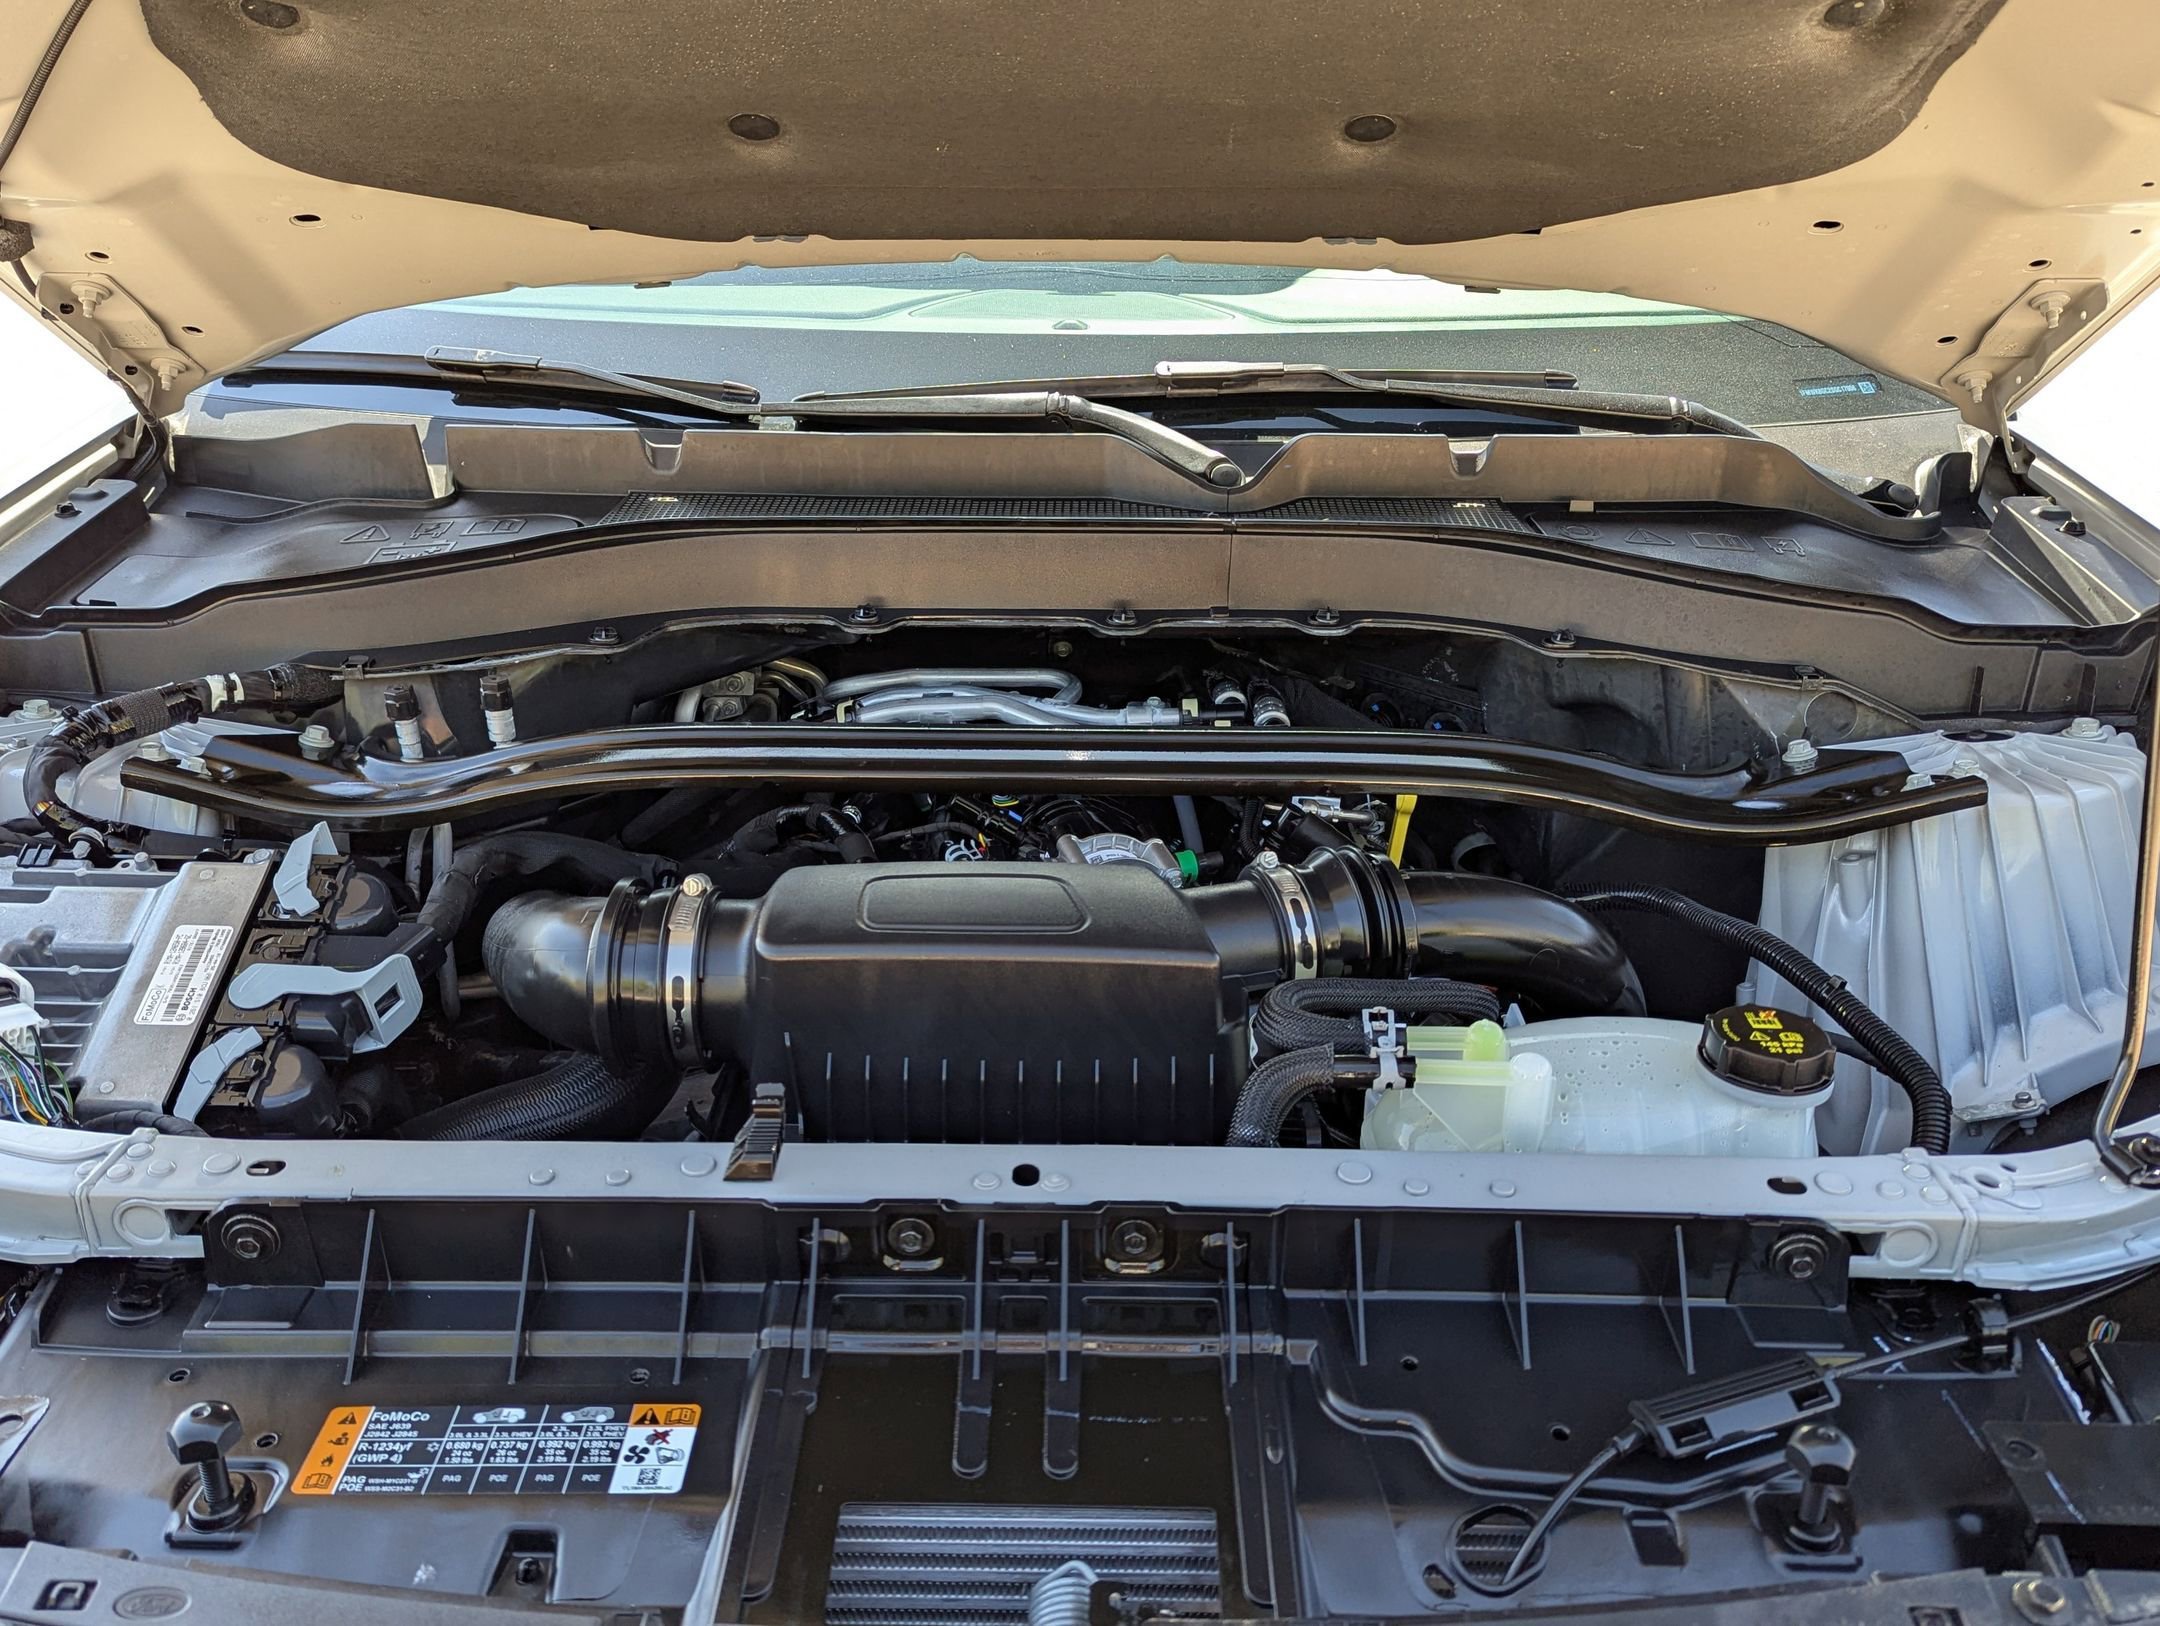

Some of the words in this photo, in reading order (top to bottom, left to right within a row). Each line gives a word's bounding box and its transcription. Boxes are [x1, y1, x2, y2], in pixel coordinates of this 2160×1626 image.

[182, 988, 197, 1011] BOSCH
[141, 990, 162, 1021] FoMoCo
[371, 1411, 430, 1422] FoMoCo
[358, 1442, 413, 1452] R-1234yf
[445, 1441, 471, 1449] 0.680
[471, 1441, 484, 1451] kg
[490, 1441, 515, 1449] 0.737
[516, 1441, 528, 1450] kg
[564, 1441, 576, 1450] kg
[608, 1441, 621, 1450] kg
[352, 1454, 388, 1464] (GWP
[390, 1454, 403, 1464] 4)
[342, 1476, 366, 1484] PAG
